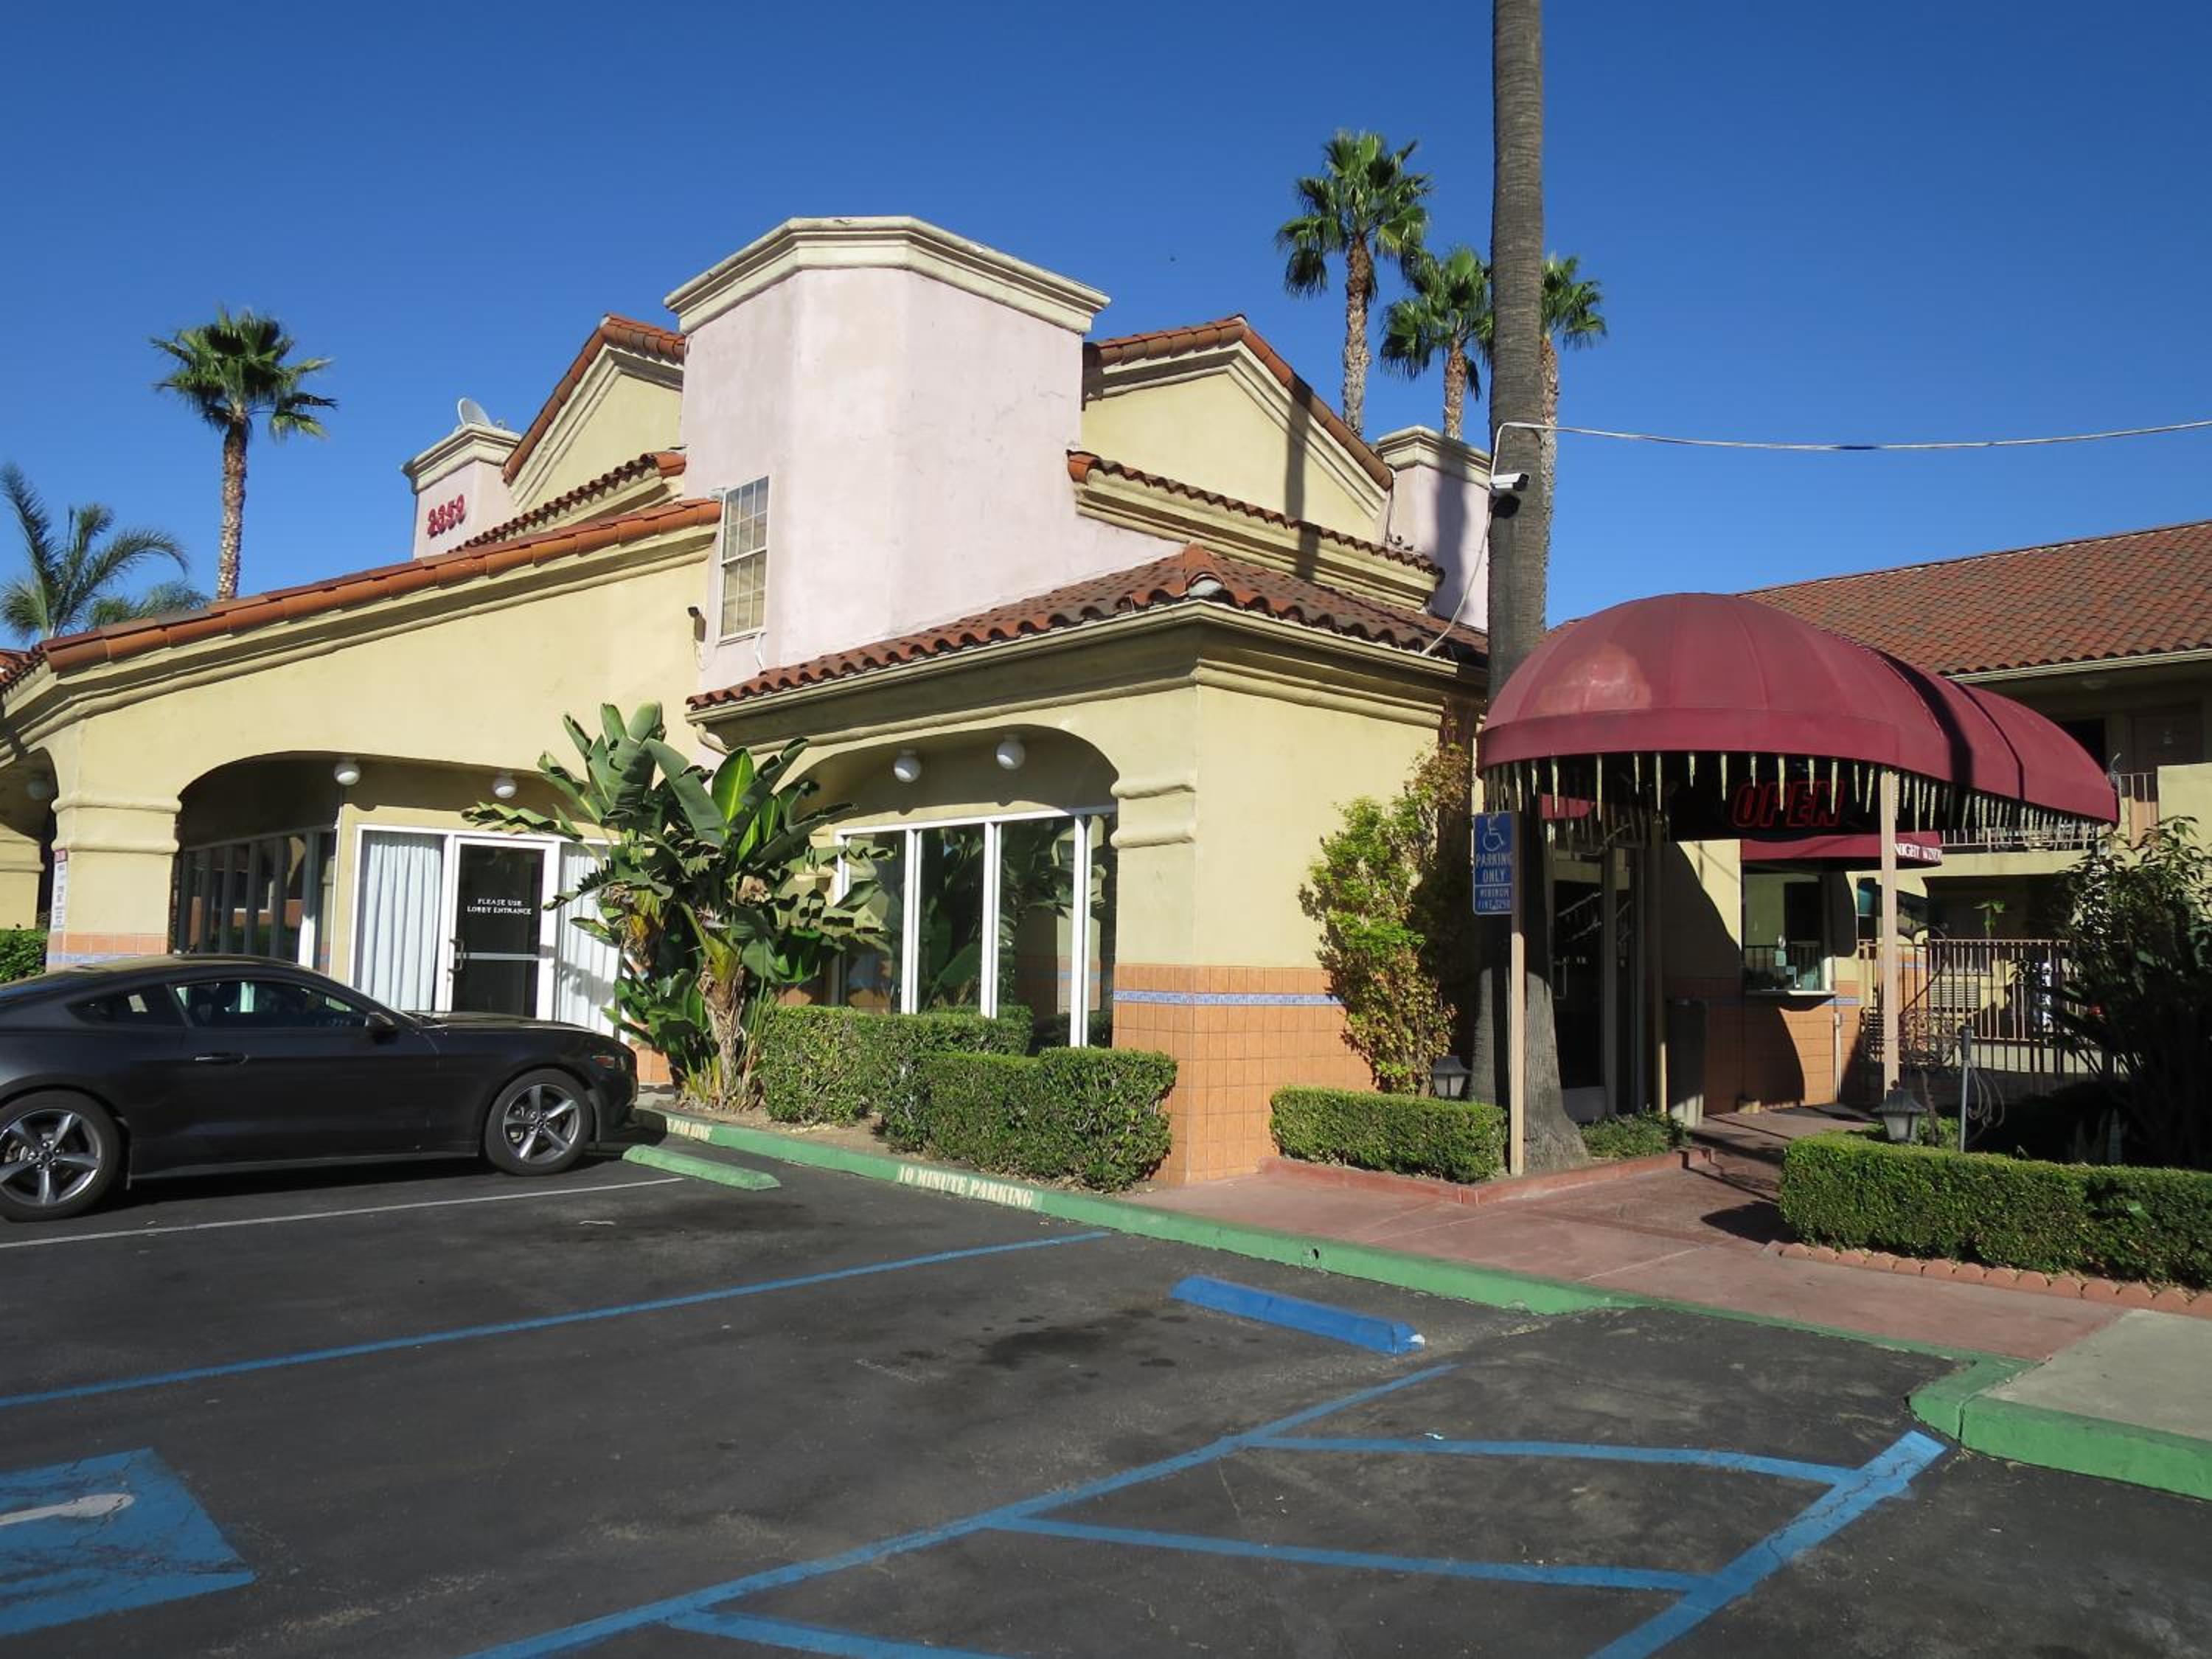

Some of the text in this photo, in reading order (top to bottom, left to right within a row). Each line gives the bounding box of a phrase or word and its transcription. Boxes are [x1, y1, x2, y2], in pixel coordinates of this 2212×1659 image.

[1733, 779, 1846, 827] OPEN
[1894, 843, 1920, 859] NIGHT
[1483, 868, 1505, 883] ONLY
[493, 907, 532, 915] ENTRANCE
[917, 1169, 967, 1195] MINUTE
[970, 1179, 1034, 1208] PARKING
